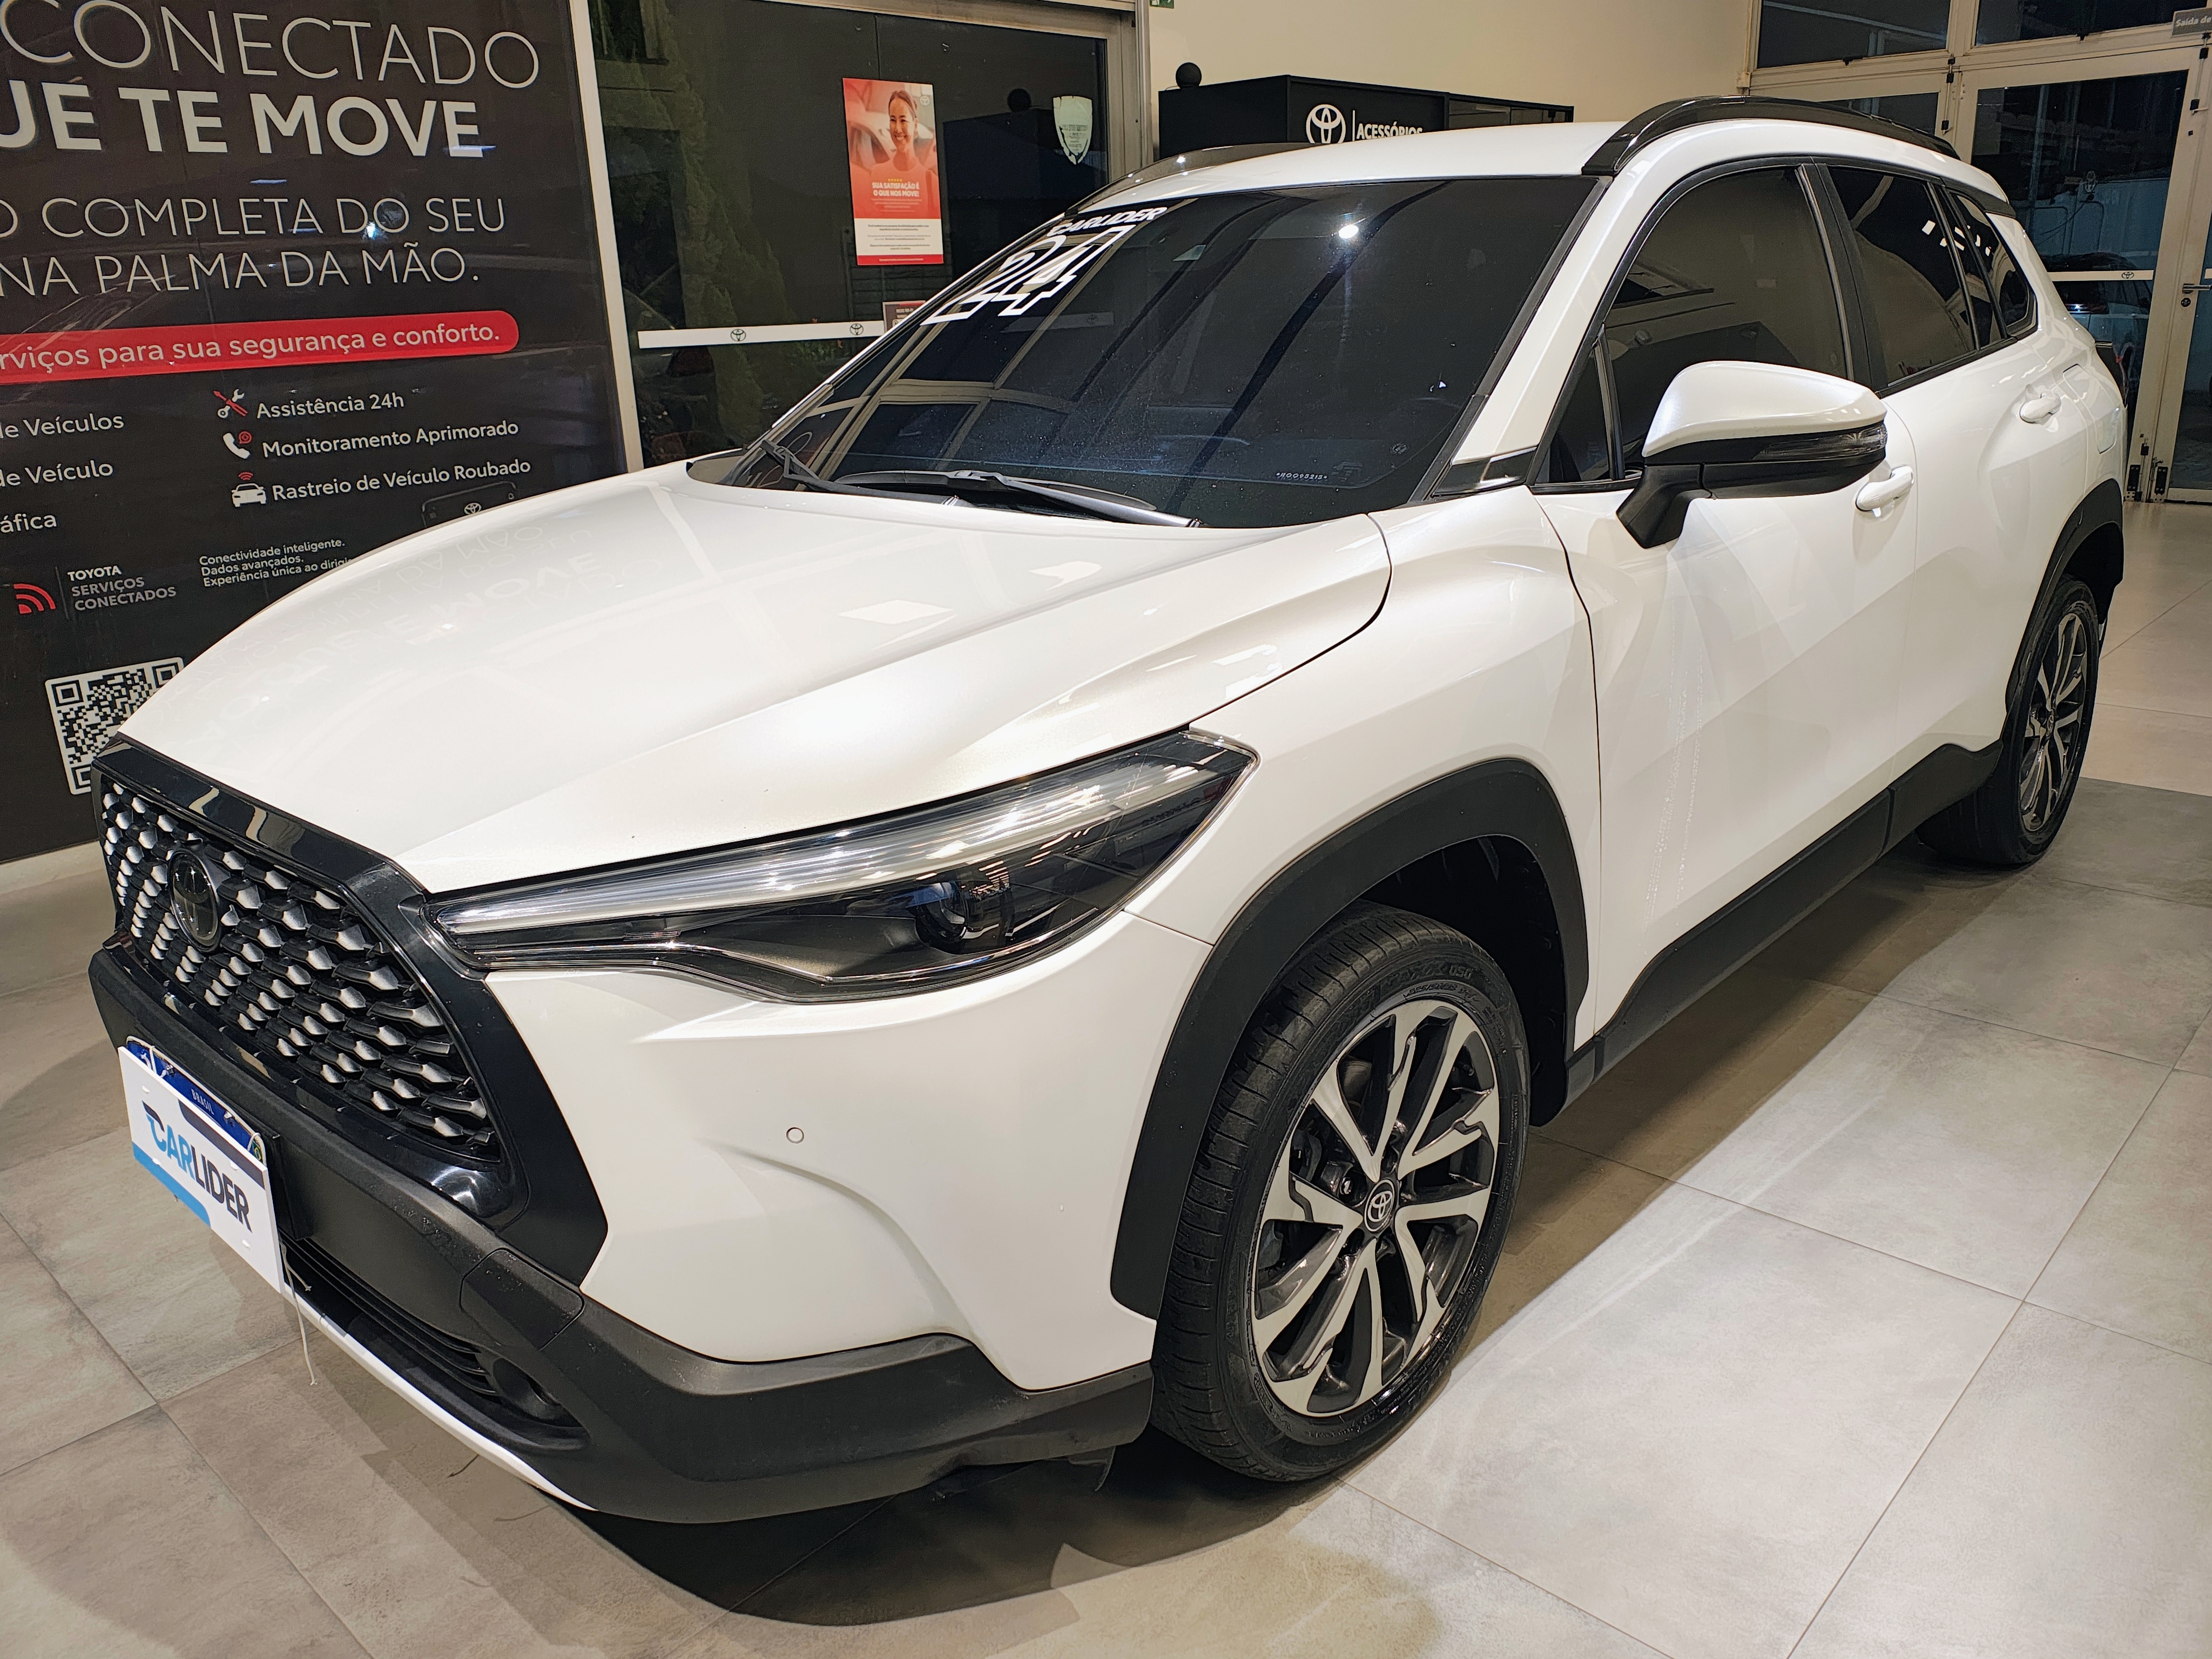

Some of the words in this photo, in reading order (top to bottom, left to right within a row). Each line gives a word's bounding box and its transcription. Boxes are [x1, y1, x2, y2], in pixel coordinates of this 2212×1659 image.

[2175, 17, 2199, 27] Saída
[1, 0, 539, 89] CONECTADO
[118, 87, 228, 153] TE
[250, 93, 483, 158] MOVE
[42, 198, 323, 238] COMPLETA
[336, 198, 409, 233] DO
[426, 198, 505, 232] SEU
[1046, 207, 1168, 237] CARLIDER
[0, 257, 79, 297] NA
[95, 252, 267, 294] PALMA
[280, 251, 350, 287] DA
[362, 241, 479, 285] MÃO.
[98, 343, 164, 369] para
[172, 340, 221, 360] sua
[230, 333, 365, 360] segurança
[372, 332, 387, 348] e
[393, 322, 500, 347] conforto.
[256, 396, 365, 419] Assistência
[369, 392, 404, 410] 24h
[23, 413, 124, 436] Veículos
[262, 430, 412, 458] Monitoramento
[415, 420, 519, 446] Aprimorado
[24, 460, 114, 484] Veículo
[272, 478, 352, 501] Rastreio
[356, 474, 380, 491] de
[383, 468, 450, 488] Veículo
[454, 458, 531, 481] Roubado
[0, 514, 57, 533] áfica
[199, 545, 281, 566] Conectividade
[282, 539, 346, 555] inteligente.
[201, 562, 239, 577] Dados
[241, 555, 304, 571] avançados.
[67, 565, 122, 582] TOYOTA
[71, 577, 145, 597] SERVIÇOS
[203, 570, 269, 588] Experiência
[272, 565, 302, 577] única
[304, 563, 318, 572] ao
[75, 586, 177, 611] CONECTADOS
[190, 1088, 215, 1116] BRASIL
[141, 1100, 253, 1233] CARLIDER
